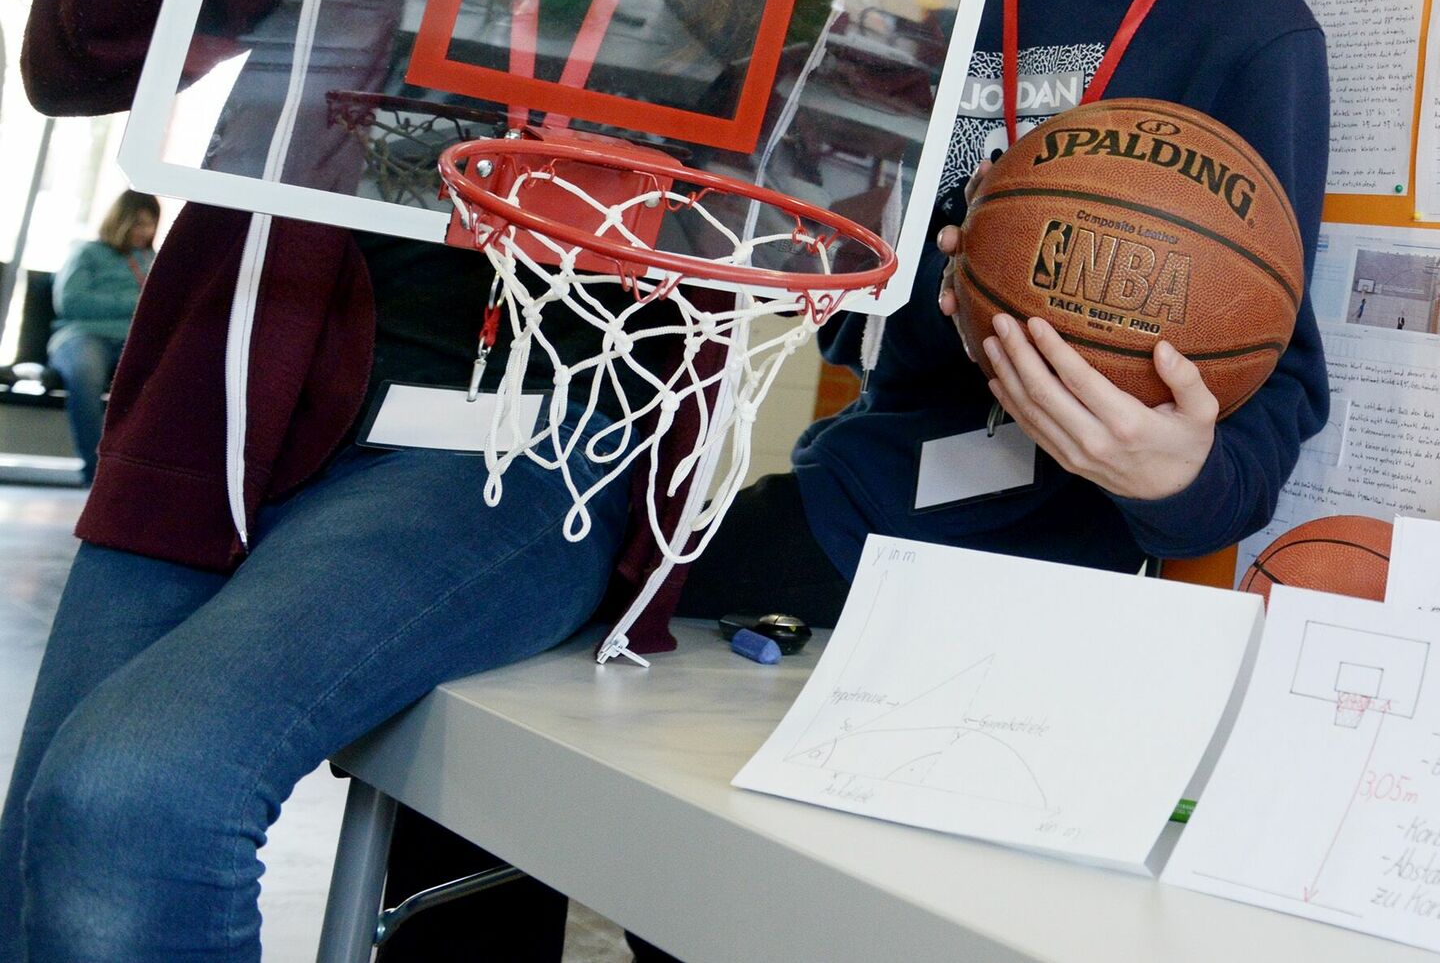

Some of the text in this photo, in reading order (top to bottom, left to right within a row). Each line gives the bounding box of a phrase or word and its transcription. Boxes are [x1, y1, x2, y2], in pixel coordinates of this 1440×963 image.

[960, 76, 1082, 111] JODAN
[1033, 127, 1257, 220] SPALDING
[1076, 210, 1135, 234] Composite
[1061, 227, 1191, 325] NBA
[1048, 296, 1161, 335] TACK SOFT PRO
